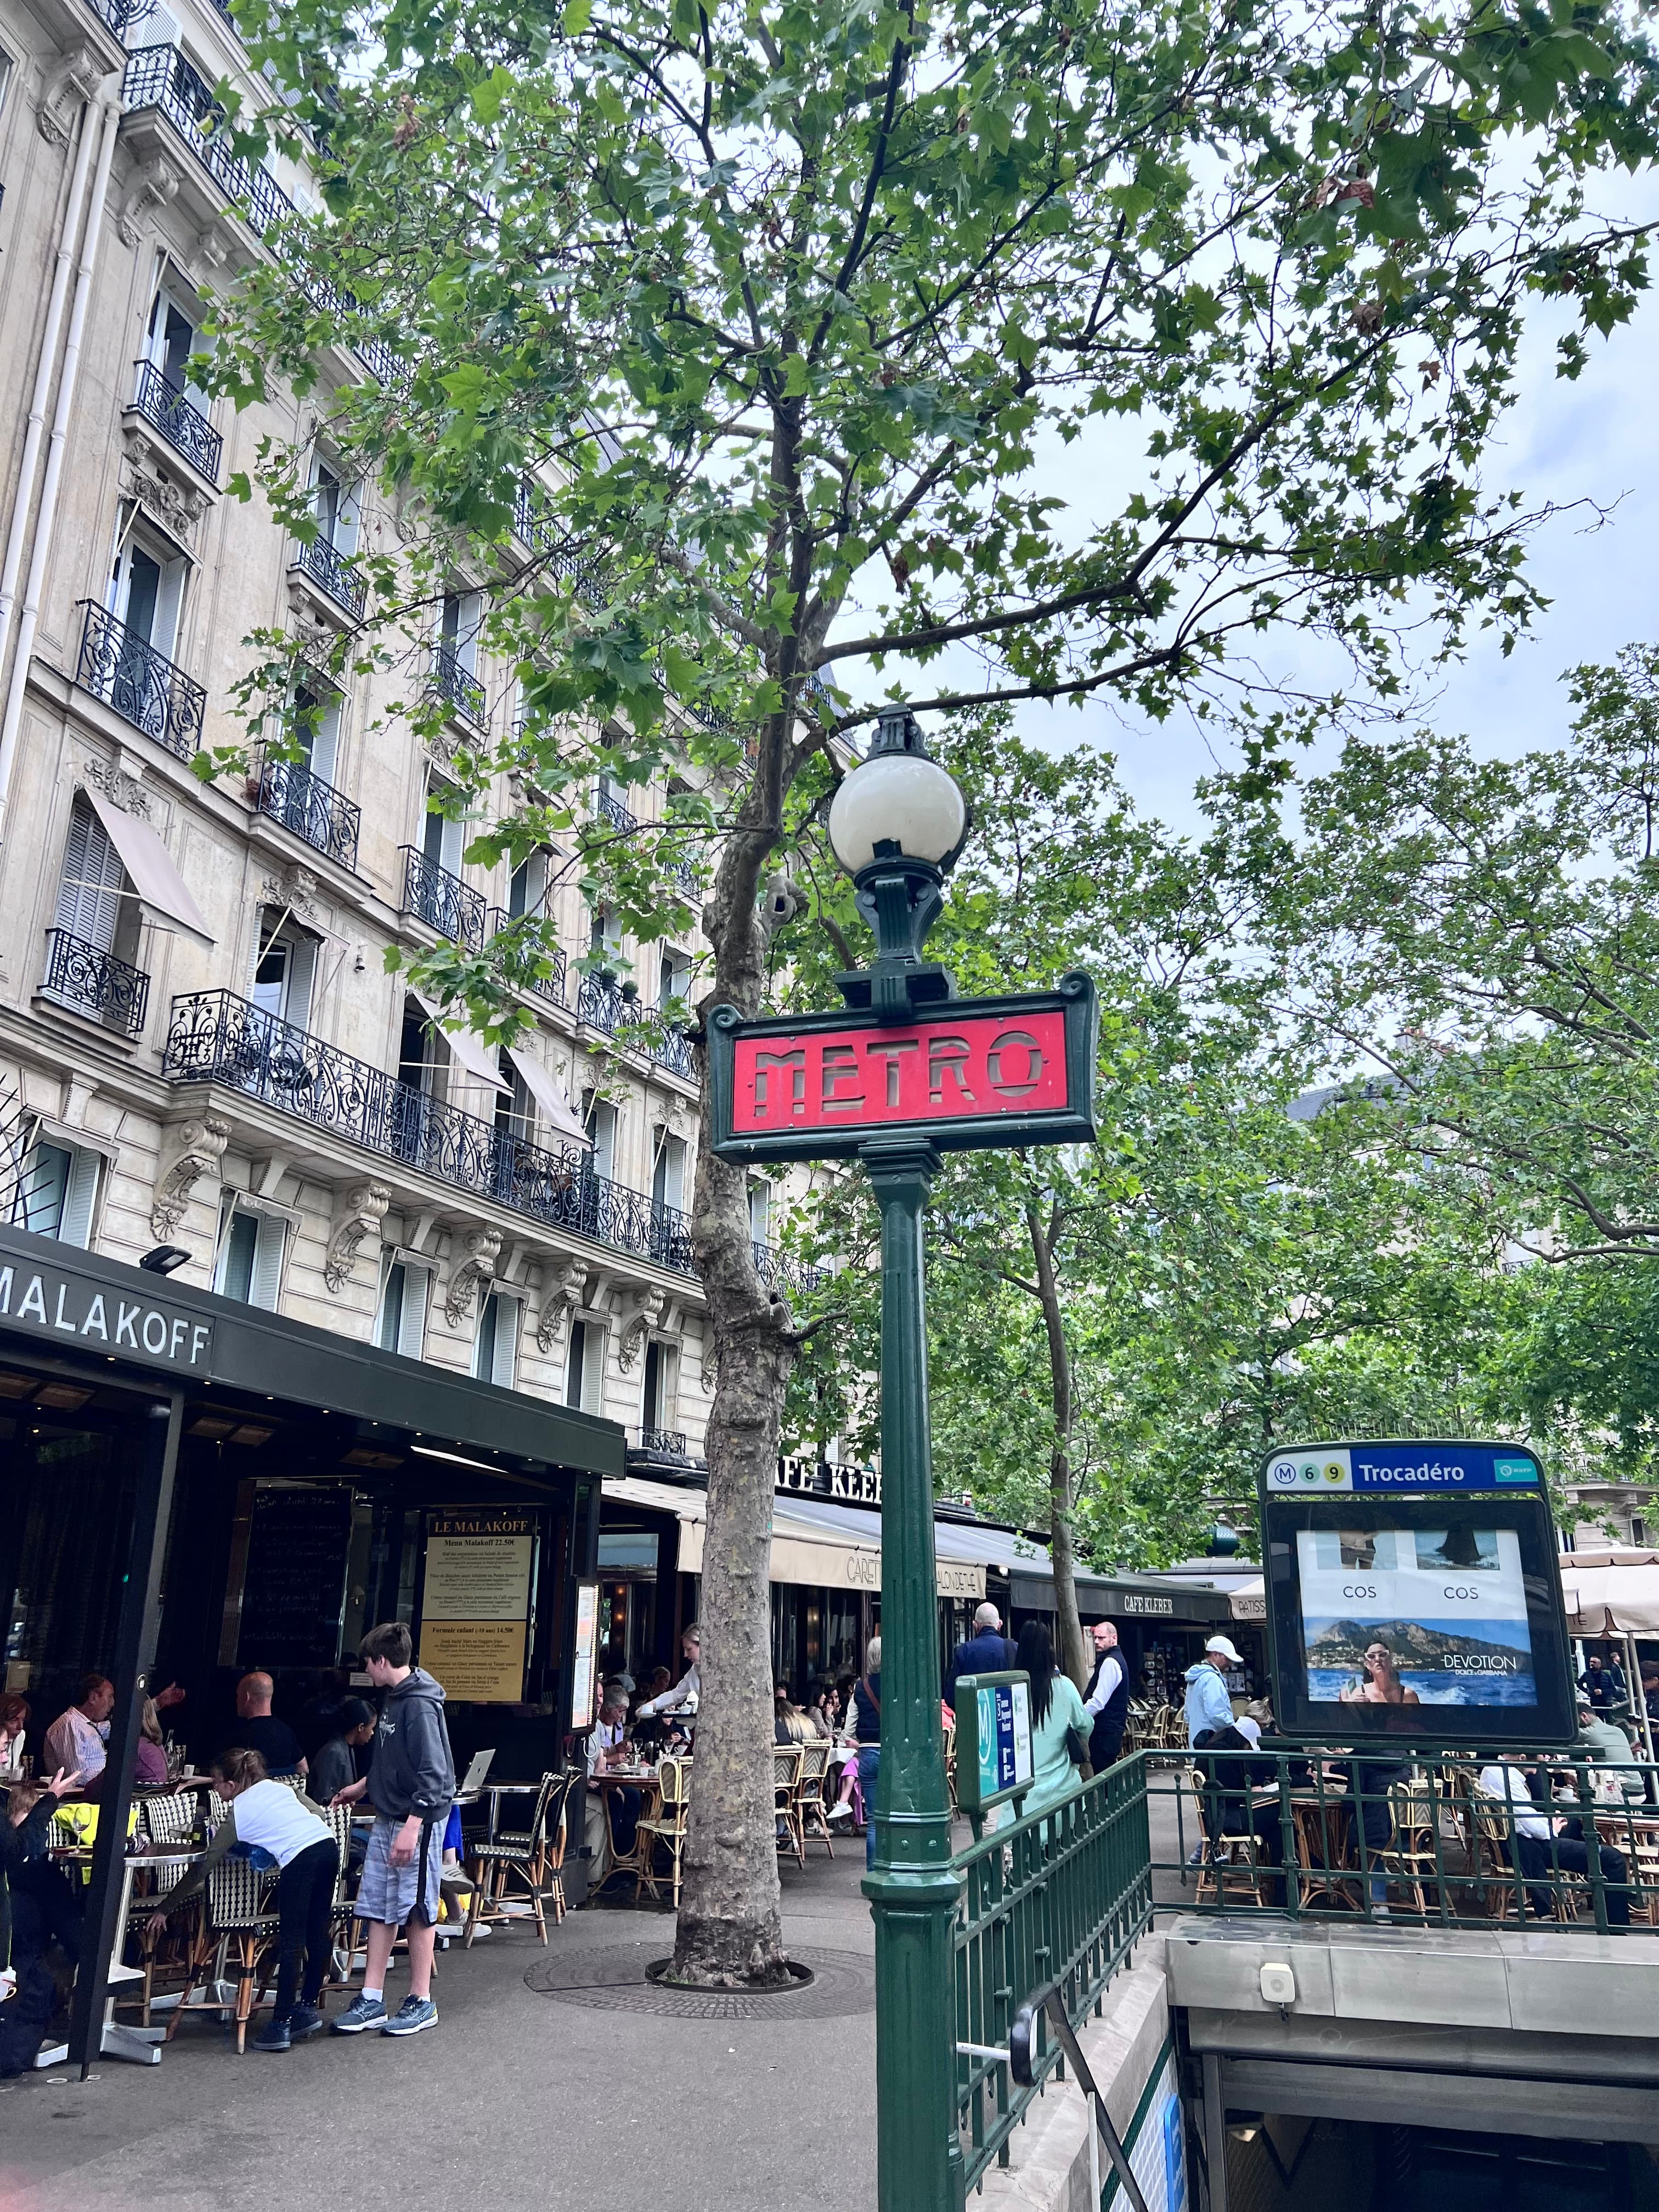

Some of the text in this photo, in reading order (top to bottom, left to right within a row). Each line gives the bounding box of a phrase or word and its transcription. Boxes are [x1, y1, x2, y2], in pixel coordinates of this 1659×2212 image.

[755, 1030, 1044, 1118] METRO
[1305, 1468, 1314, 1480] 6
[1329, 1467, 1339, 1480] 9
[1358, 1463, 1465, 1482] Trocadéro
[435, 1521, 528, 1532] LE MALAKOFF
[1343, 1586, 1376, 1599] COS
[1444, 1587, 1479, 1600] COS
[1144, 1596, 1173, 1614] KLEBER
[1238, 1599, 1266, 1613] PATISS
[1442, 1654, 1517, 1669] DEVOTION
